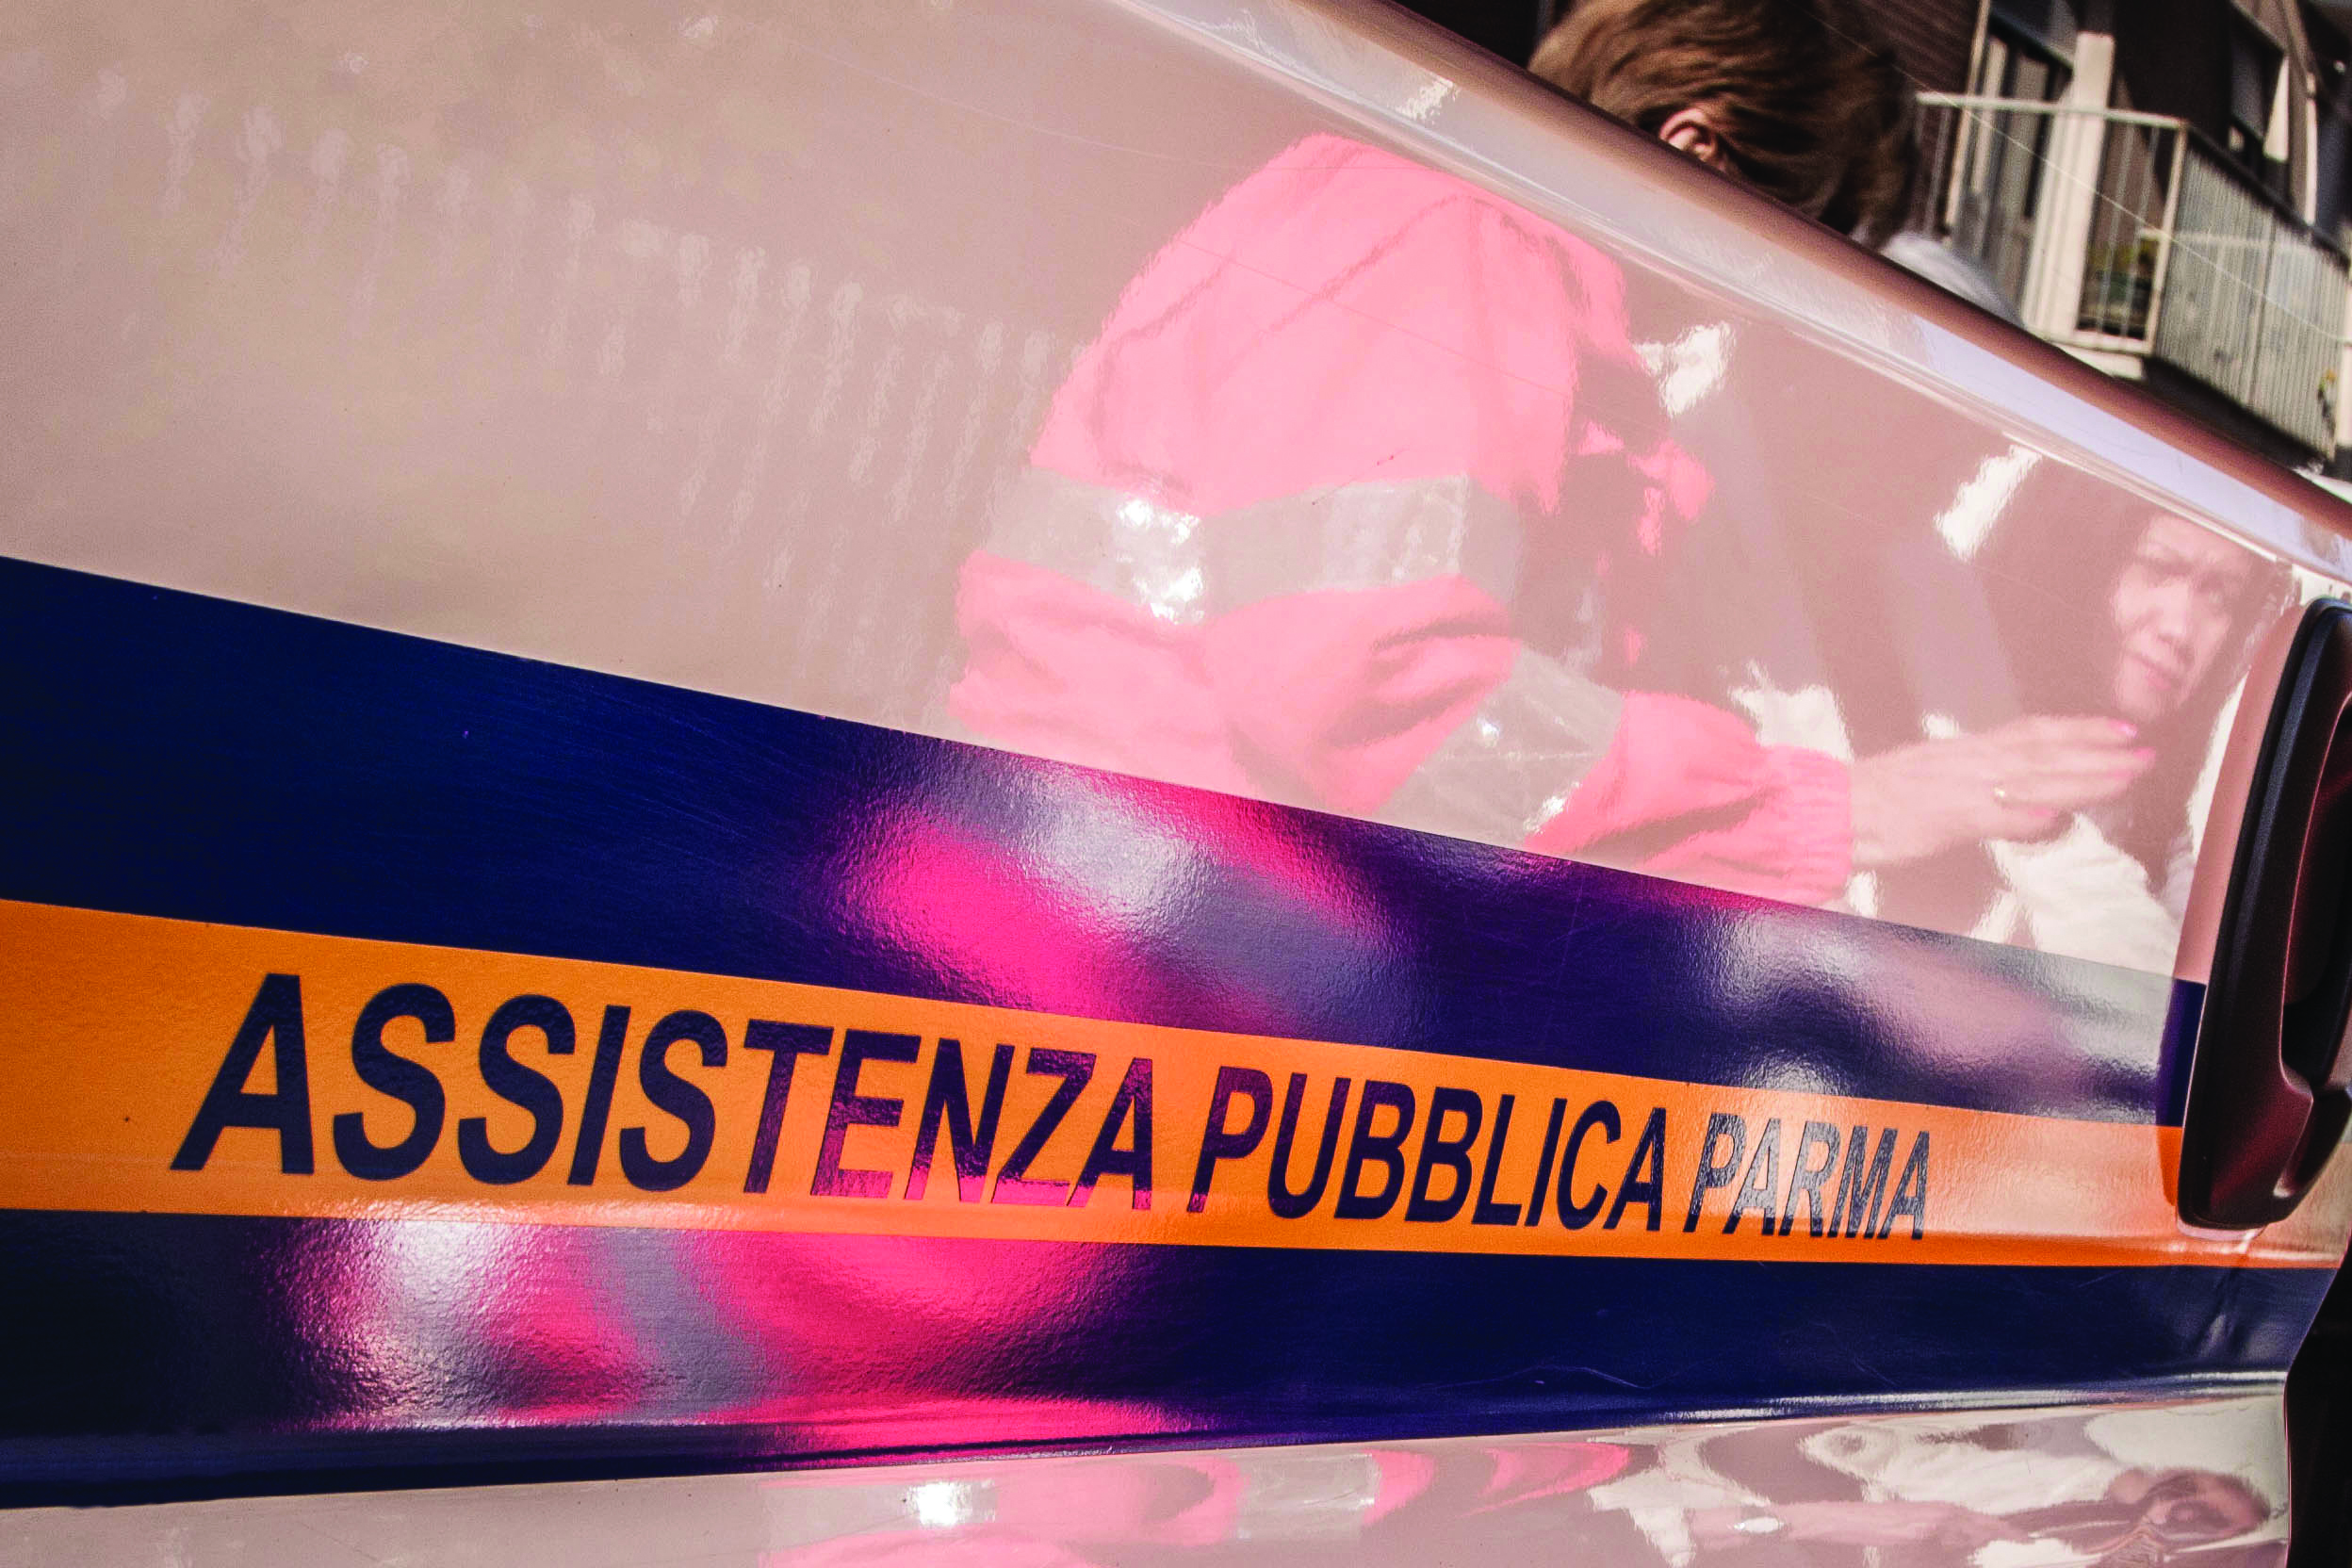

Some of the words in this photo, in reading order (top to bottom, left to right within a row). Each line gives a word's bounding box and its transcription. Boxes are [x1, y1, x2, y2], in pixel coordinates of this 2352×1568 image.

[170, 972, 1152, 1209] ASSISTENZA
[1187, 1066, 1667, 1232] PUBBLICA
[1684, 1112, 1931, 1240] PARMA
